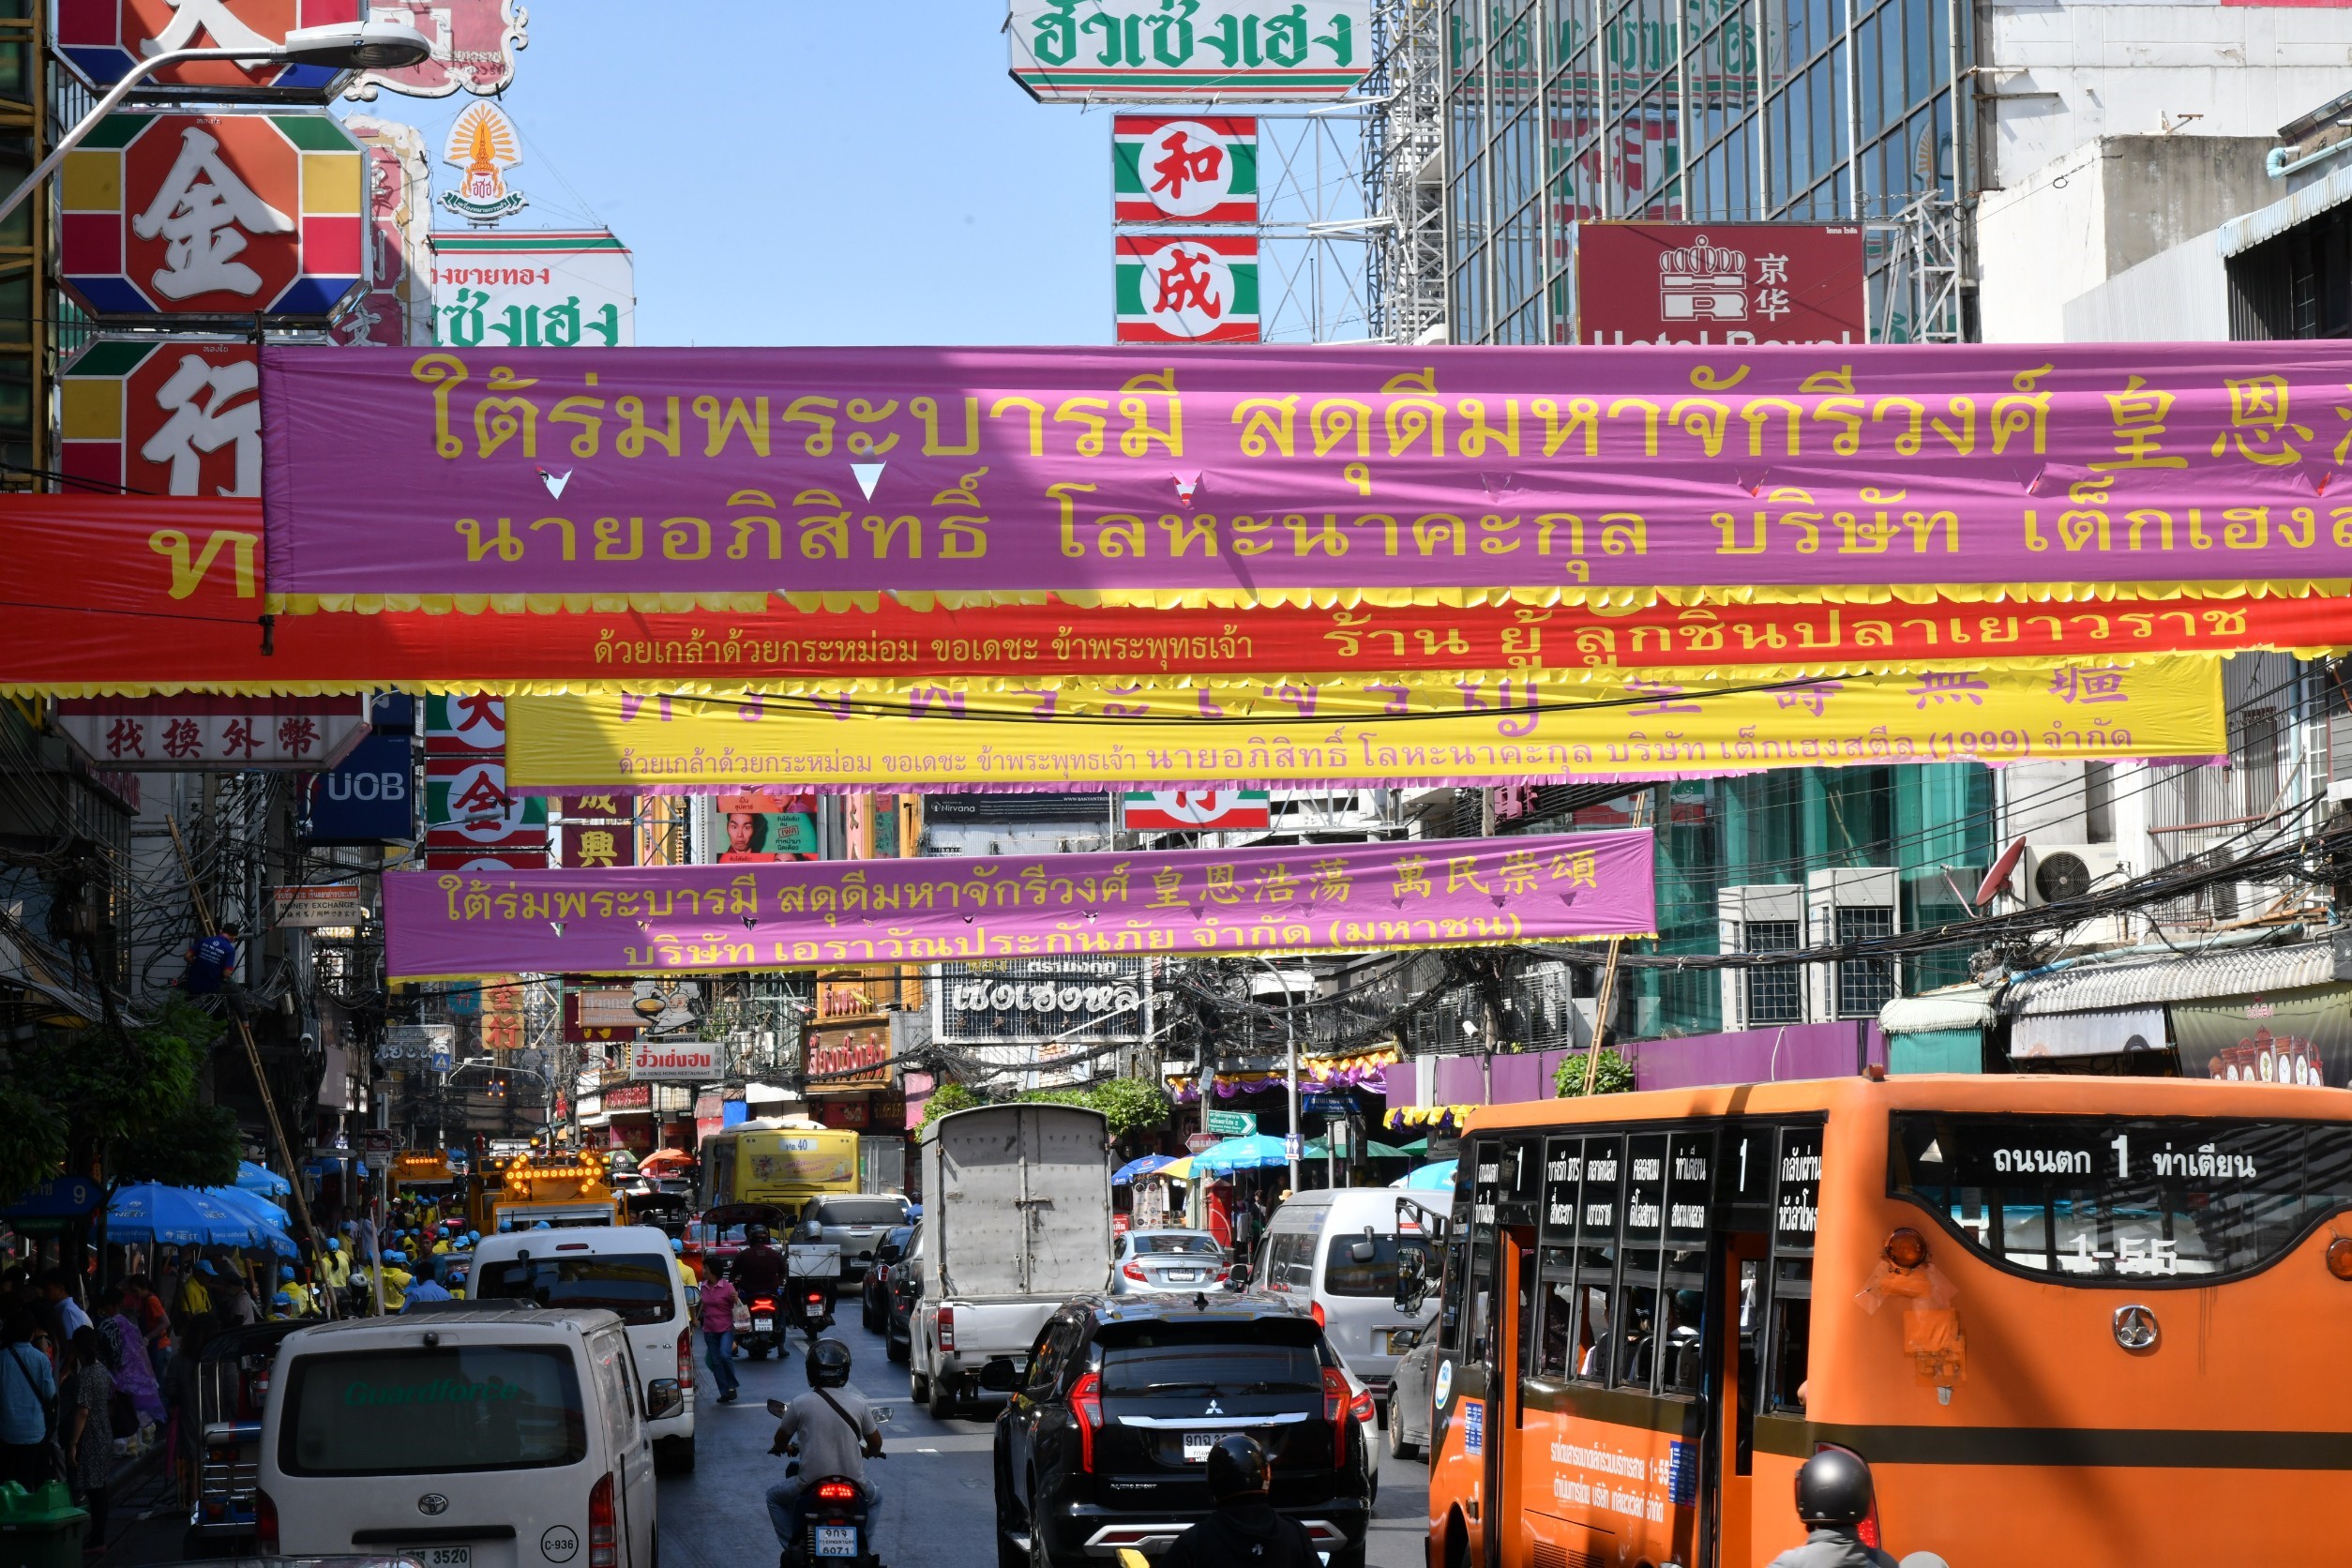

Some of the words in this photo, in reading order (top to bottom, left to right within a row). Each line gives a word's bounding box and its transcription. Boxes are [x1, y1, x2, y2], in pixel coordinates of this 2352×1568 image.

[1032, 0, 1352, 68] ฮวเซงเฮง
[1150, 131, 1223, 199] 和
[133, 127, 295, 299] 金
[1153, 249, 1220, 320] 成
[1754, 254, 1791, 322] 京华
[411, 352, 1185, 460] ใต้ร่มพระบารมี
[1230, 363, 2054, 496] สดุดีมหาจักรีวงศ์
[2087, 374, 2352, 474] 皇恩
[456, 466, 990, 562] นายอภิสิทธิ์
[1046, 481, 1649, 583] โลหะนาคะกุล
[1711, 487, 1959, 555] บริษัท
[594, 627, 919, 665] ด้วยเกล้าด้วยกระหม่อม
[930, 629, 1039, 662] ขอเดชะ
[1051, 624, 1253, 671] ข้าพระพุทธเจ้า
[1323, 611, 1470, 656] ร้าน
[106, 716, 321, 760] 找換外幣
[618, 746, 872, 775] ด้วยเกล้าด้วยกระหม่อม
[882, 748, 967, 774] ขอเดชะ
[976, 744, 1137, 781] ข้าพระพุทธเจ้า
[1146, 726, 1349, 771] นายอภิสิทธิ์
[1358, 731, 1592, 776] โลหะนาคะกุล
[1606, 730, 1707, 763] บริษัท
[1718, 723, 1916, 761] เต็กเฮงสตีล
[1927, 729, 2031, 759] (1999)
[2042, 717, 2133, 751] จำกัด
[328, 771, 405, 801] UOB
[941, 805, 976, 814] Nirvana
[437, 871, 759, 923] ใต้ร่มพระบารมี
[776, 860, 1131, 927] สดุดีมหาจักรีวงศ์
[1145, 859, 1351, 909] 皇恩浩蕩
[625, 932, 756, 967] บริษัท
[775, 914, 1176, 964] เอราวัณประกันภัย
[1190, 912, 1313, 950] จำกัด
[1328, 912, 1523, 948] (มหาชน)
[636, 1045, 711, 1068] ฮั่วเซ่งฮง
[1516, 1146, 1524, 1192] 1
[1567, 1157, 1581, 1182] BTS
[1675, 1145, 1707, 1181] ท่าเตียน
[1740, 1138, 1748, 1192] 1
[1781, 1145, 1822, 1182] กลับผ่าน
[1993, 1149, 2092, 1174] ถนนตก
[2111, 1135, 2129, 1178] 1
[2152, 1142, 2257, 1178] ท่าเตียน
[73, 1185, 86, 1204] 9
[1586, 1203, 1613, 1226] เยาวราช
[1670, 1202, 1705, 1229] สนามหลวง
[2069, 1233, 2178, 1274] 1-55
[344, 1378, 520, 1407] Guardforce
[433, 1549, 468, 1564] 3520
[544, 1540, 574, 1550] C-936
[822, 1546, 850, 1555] 6071
